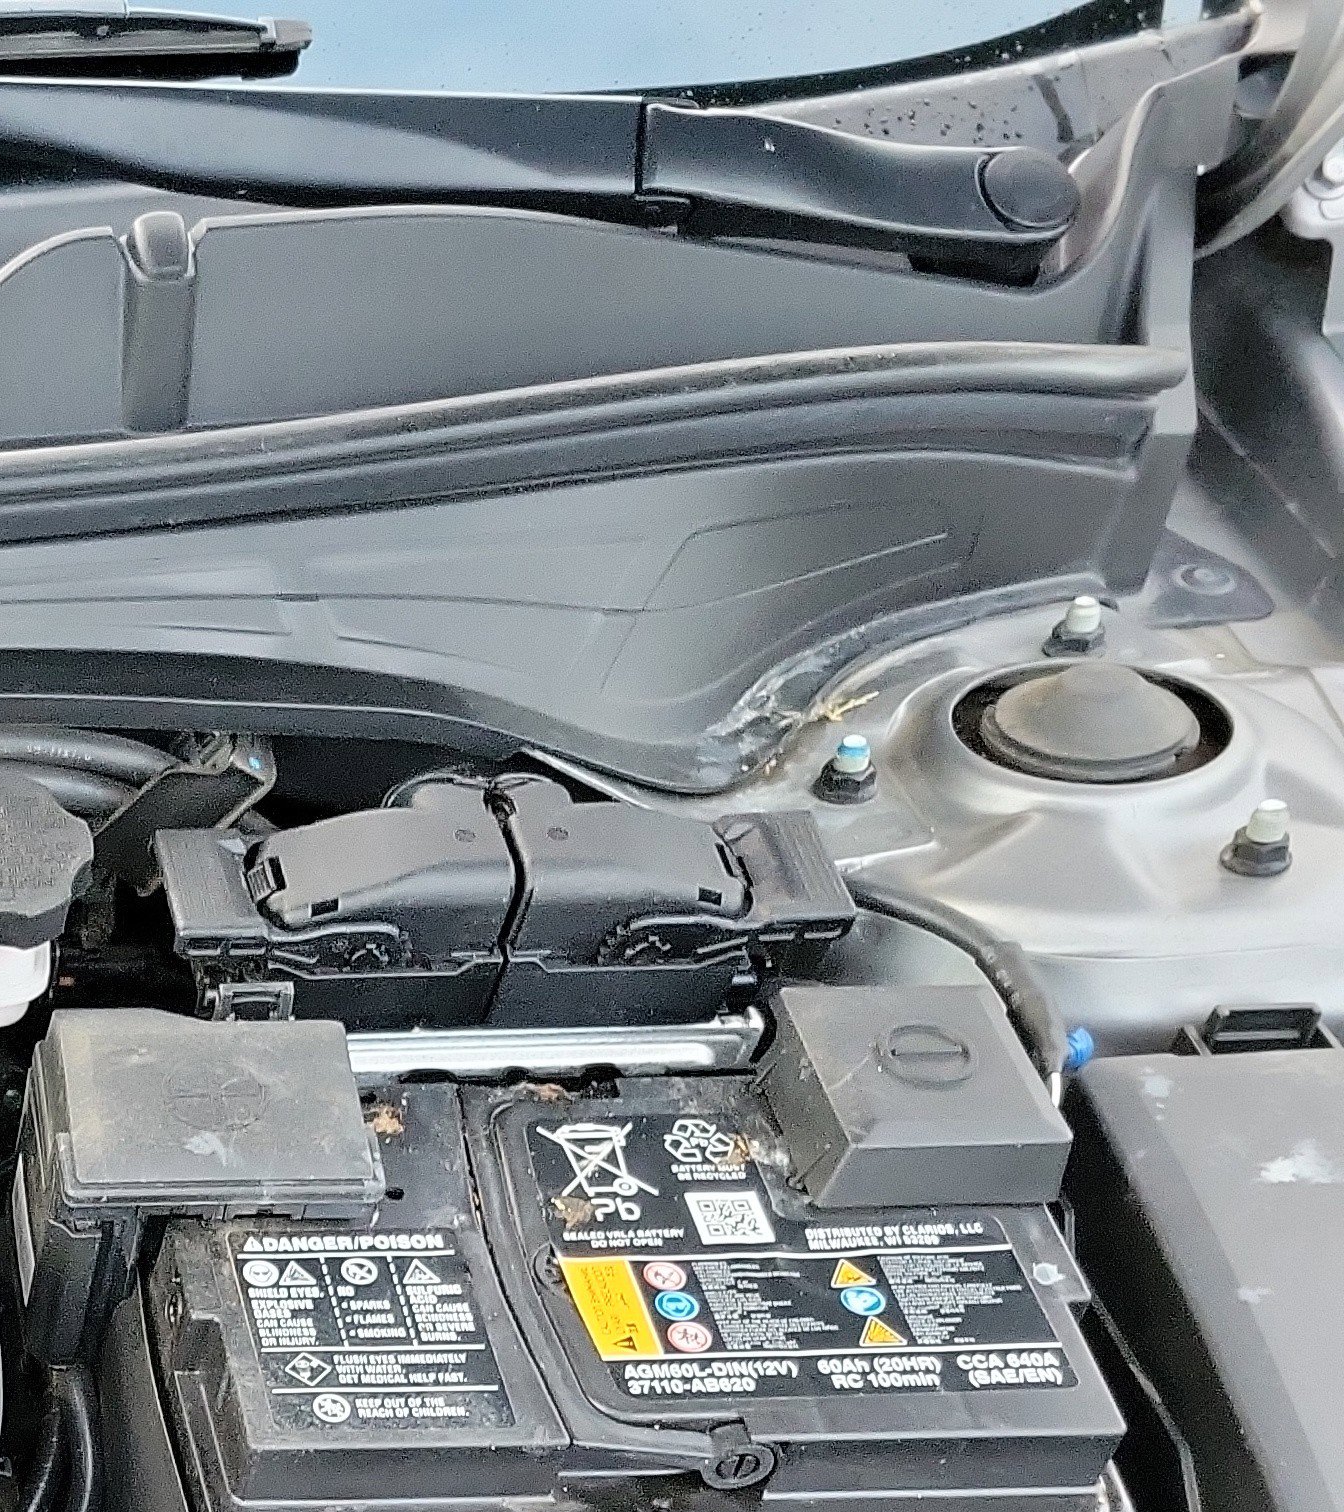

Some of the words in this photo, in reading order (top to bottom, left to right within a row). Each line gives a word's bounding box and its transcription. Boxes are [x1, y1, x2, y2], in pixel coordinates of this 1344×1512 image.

[670, 1164, 716, 1174] BATTERY
[694, 1171, 747, 1181] RECYCLED
[590, 1197, 641, 1222] Pb
[562, 1230, 605, 1241] SEALED
[636, 1227, 685, 1239] BATTERY
[804, 1226, 883, 1240] DISTRIBUTED
[883, 1225, 900, 1237] BY
[959, 1222, 984, 1235] LLC
[262, 1234, 444, 1251] DANGER/POISON
[807, 1236, 884, 1250] MILWAUKEE,
[884, 1235, 902, 1246] WI
[247, 1286, 289, 1299] SHIELD
[251, 1299, 314, 1310] EXPLOSIVE
[349, 1299, 391, 1311] SPARKS
[412, 1303, 434, 1313] CAN
[435, 1302, 471, 1313] CAUSE
[256, 1318, 278, 1328] CAN
[279, 1317, 314, 1328] CAUSE
[353, 1313, 395, 1325] FLAMES
[356, 1327, 407, 1339] SMOKING
[332, 1354, 368, 1365] FLUSH
[368, 1353, 397, 1364] EYES
[397, 1352, 467, 1364] IMMEDIATELY
[816, 1356, 871, 1375] 60Ah
[872, 1354, 943, 1375] (20HR)
[955, 1353, 1004, 1370] CCA
[1006, 1351, 1060, 1368] 640A
[623, 1360, 799, 1380] AGM60L-DIN(12V)
[360, 1373, 408, 1384] MEDICAL
[408, 1372, 437, 1384] HELP
[831, 1373, 864, 1390] RC
[867, 1370, 941, 1389] 100min
[967, 1366, 1063, 1388] (SAE/EN)
[627, 1376, 757, 1395] 37110-AB620
[354, 1397, 383, 1408] KEEP
[383, 1397, 406, 1408] OUT
[407, 1397, 423, 1408] OF
[423, 1396, 446, 1407] THE
[357, 1407, 393, 1418] REACH
[394, 1406, 410, 1418] OF
